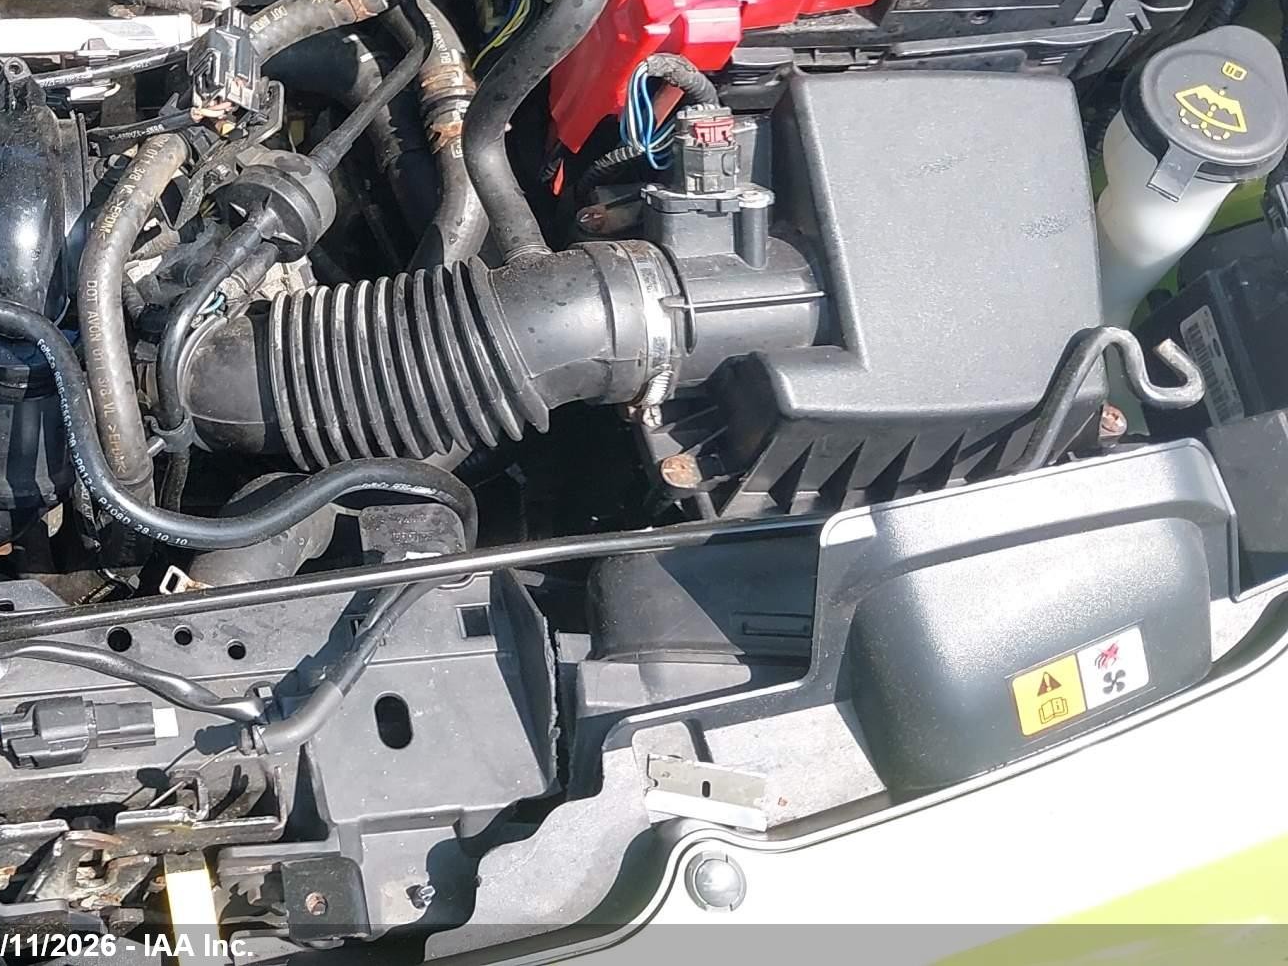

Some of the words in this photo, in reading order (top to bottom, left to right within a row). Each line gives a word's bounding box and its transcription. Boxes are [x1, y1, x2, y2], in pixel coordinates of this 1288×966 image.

[86, 279, 98, 304] DOT
[87, 310, 103, 343] AVON
[102, 401, 116, 419] VL
